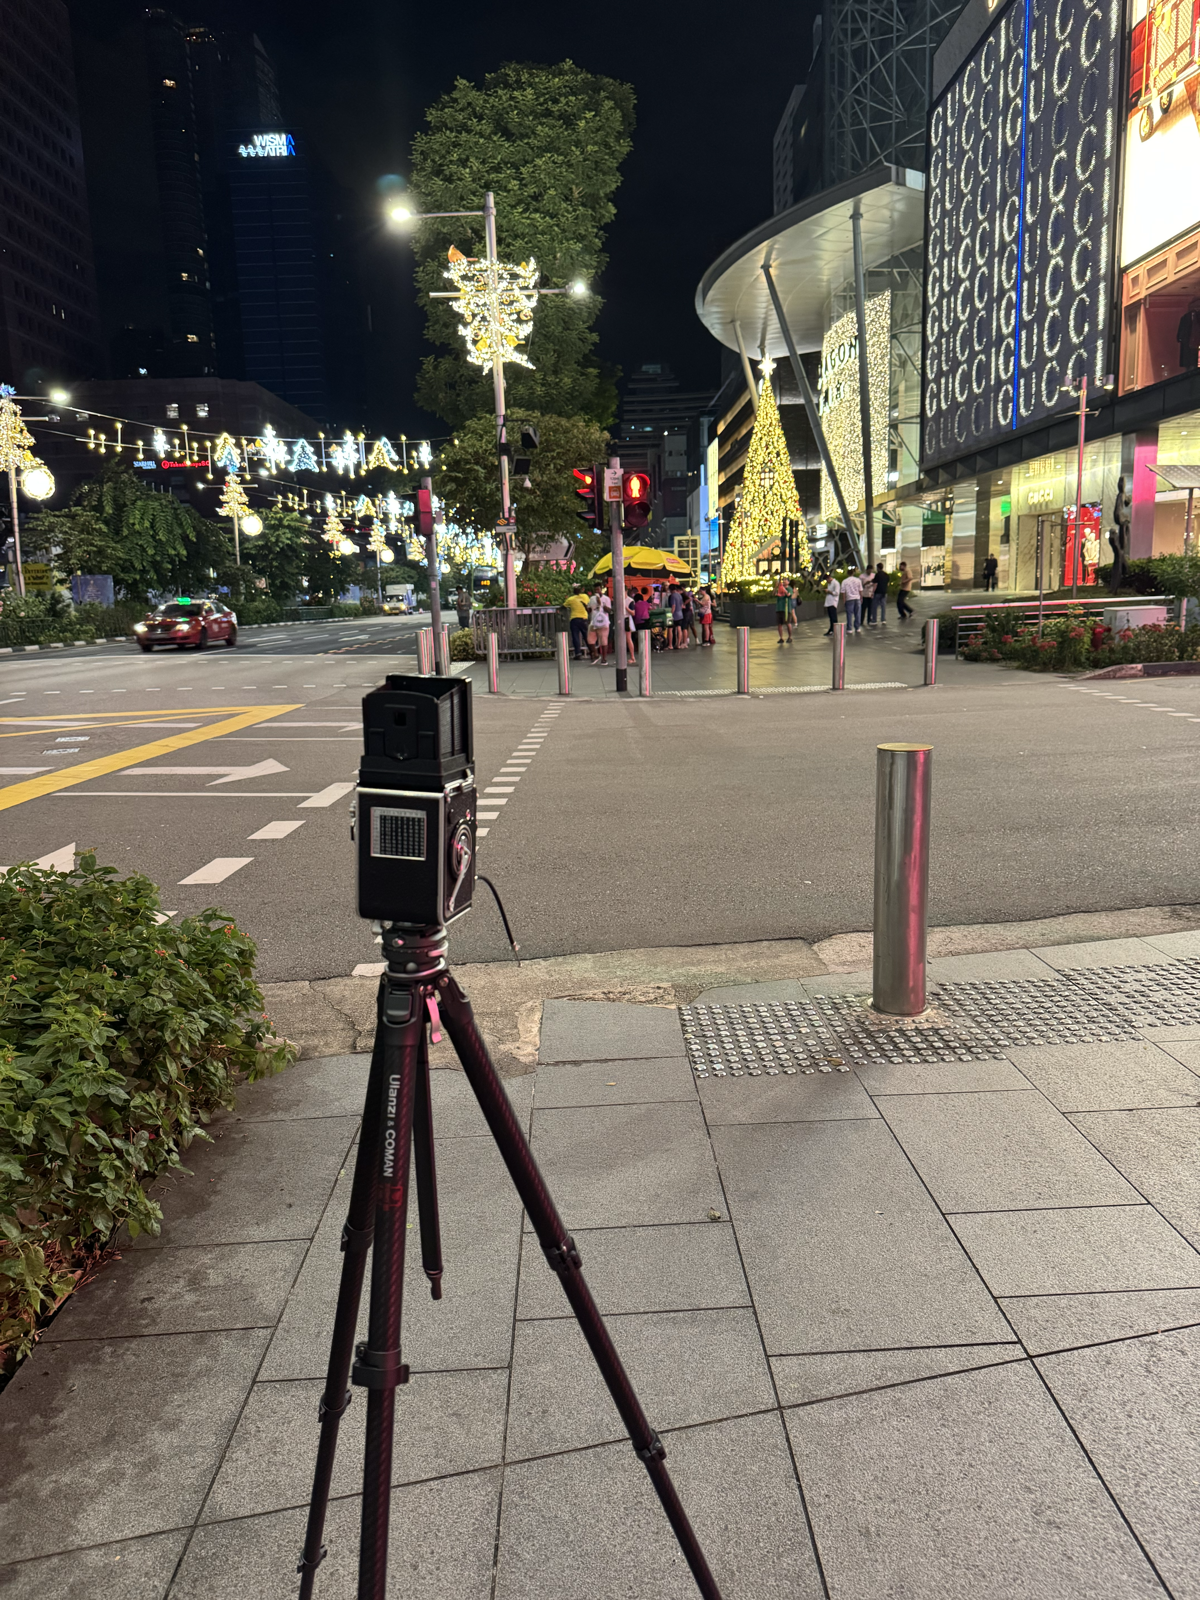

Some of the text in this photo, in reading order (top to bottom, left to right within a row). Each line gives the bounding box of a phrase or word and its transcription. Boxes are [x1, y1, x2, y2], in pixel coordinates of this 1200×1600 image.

[930, 70, 1004, 187] GUCCI
[931, 18, 1006, 146] GUCCI
[254, 134, 295, 146] WISMA
[264, 145, 296, 156] ATRIA
[928, 49, 1114, 265] GUCCI GUCCI
[929, 116, 1003, 227] GUCCI
[927, 167, 1110, 343] GUCCI GUCCI
[928, 108, 1112, 304] GUCCI GUCCI
[925, 347, 996, 417] GUCCI
[999, 281, 1106, 380] GUCCI
[926, 302, 998, 380] GUCCI
[1000, 224, 1108, 334] GUCCI
[998, 339, 1103, 425] GUCCI
[1028, 488, 1053, 505] GUCCI
[383, 1129, 396, 1177] COMAN
[388, 1075, 401, 1118] Ulanzi
